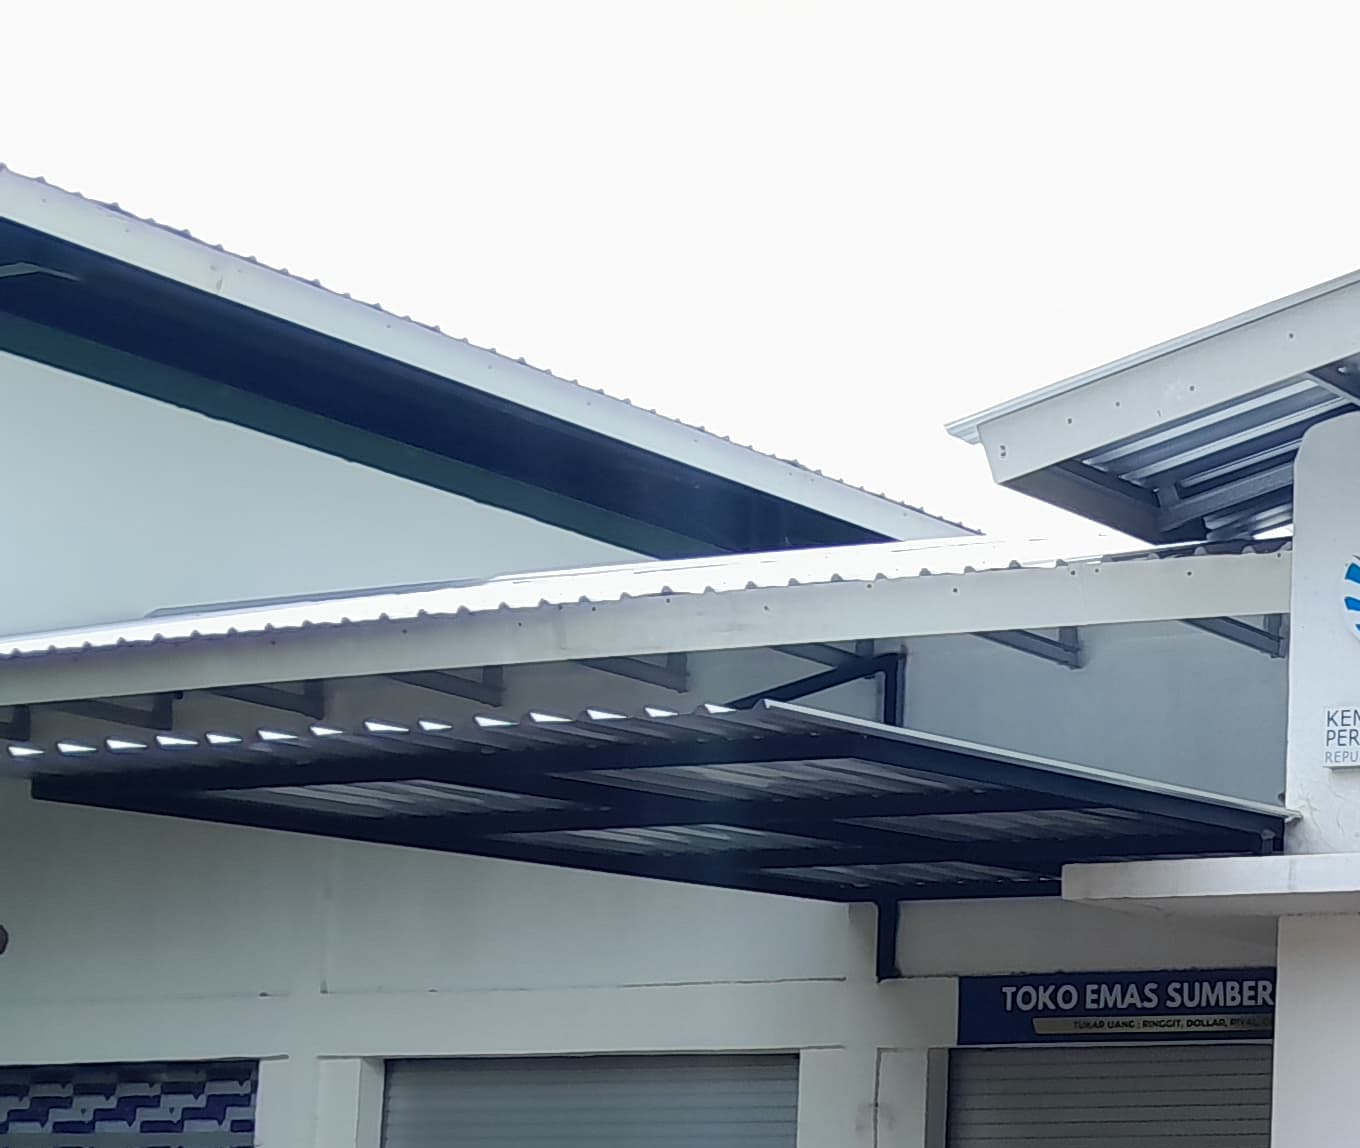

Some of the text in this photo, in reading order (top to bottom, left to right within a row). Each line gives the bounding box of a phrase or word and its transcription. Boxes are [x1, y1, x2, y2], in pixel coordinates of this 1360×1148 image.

[1001, 980, 1275, 1012] TOKO EMAS SUMBER
